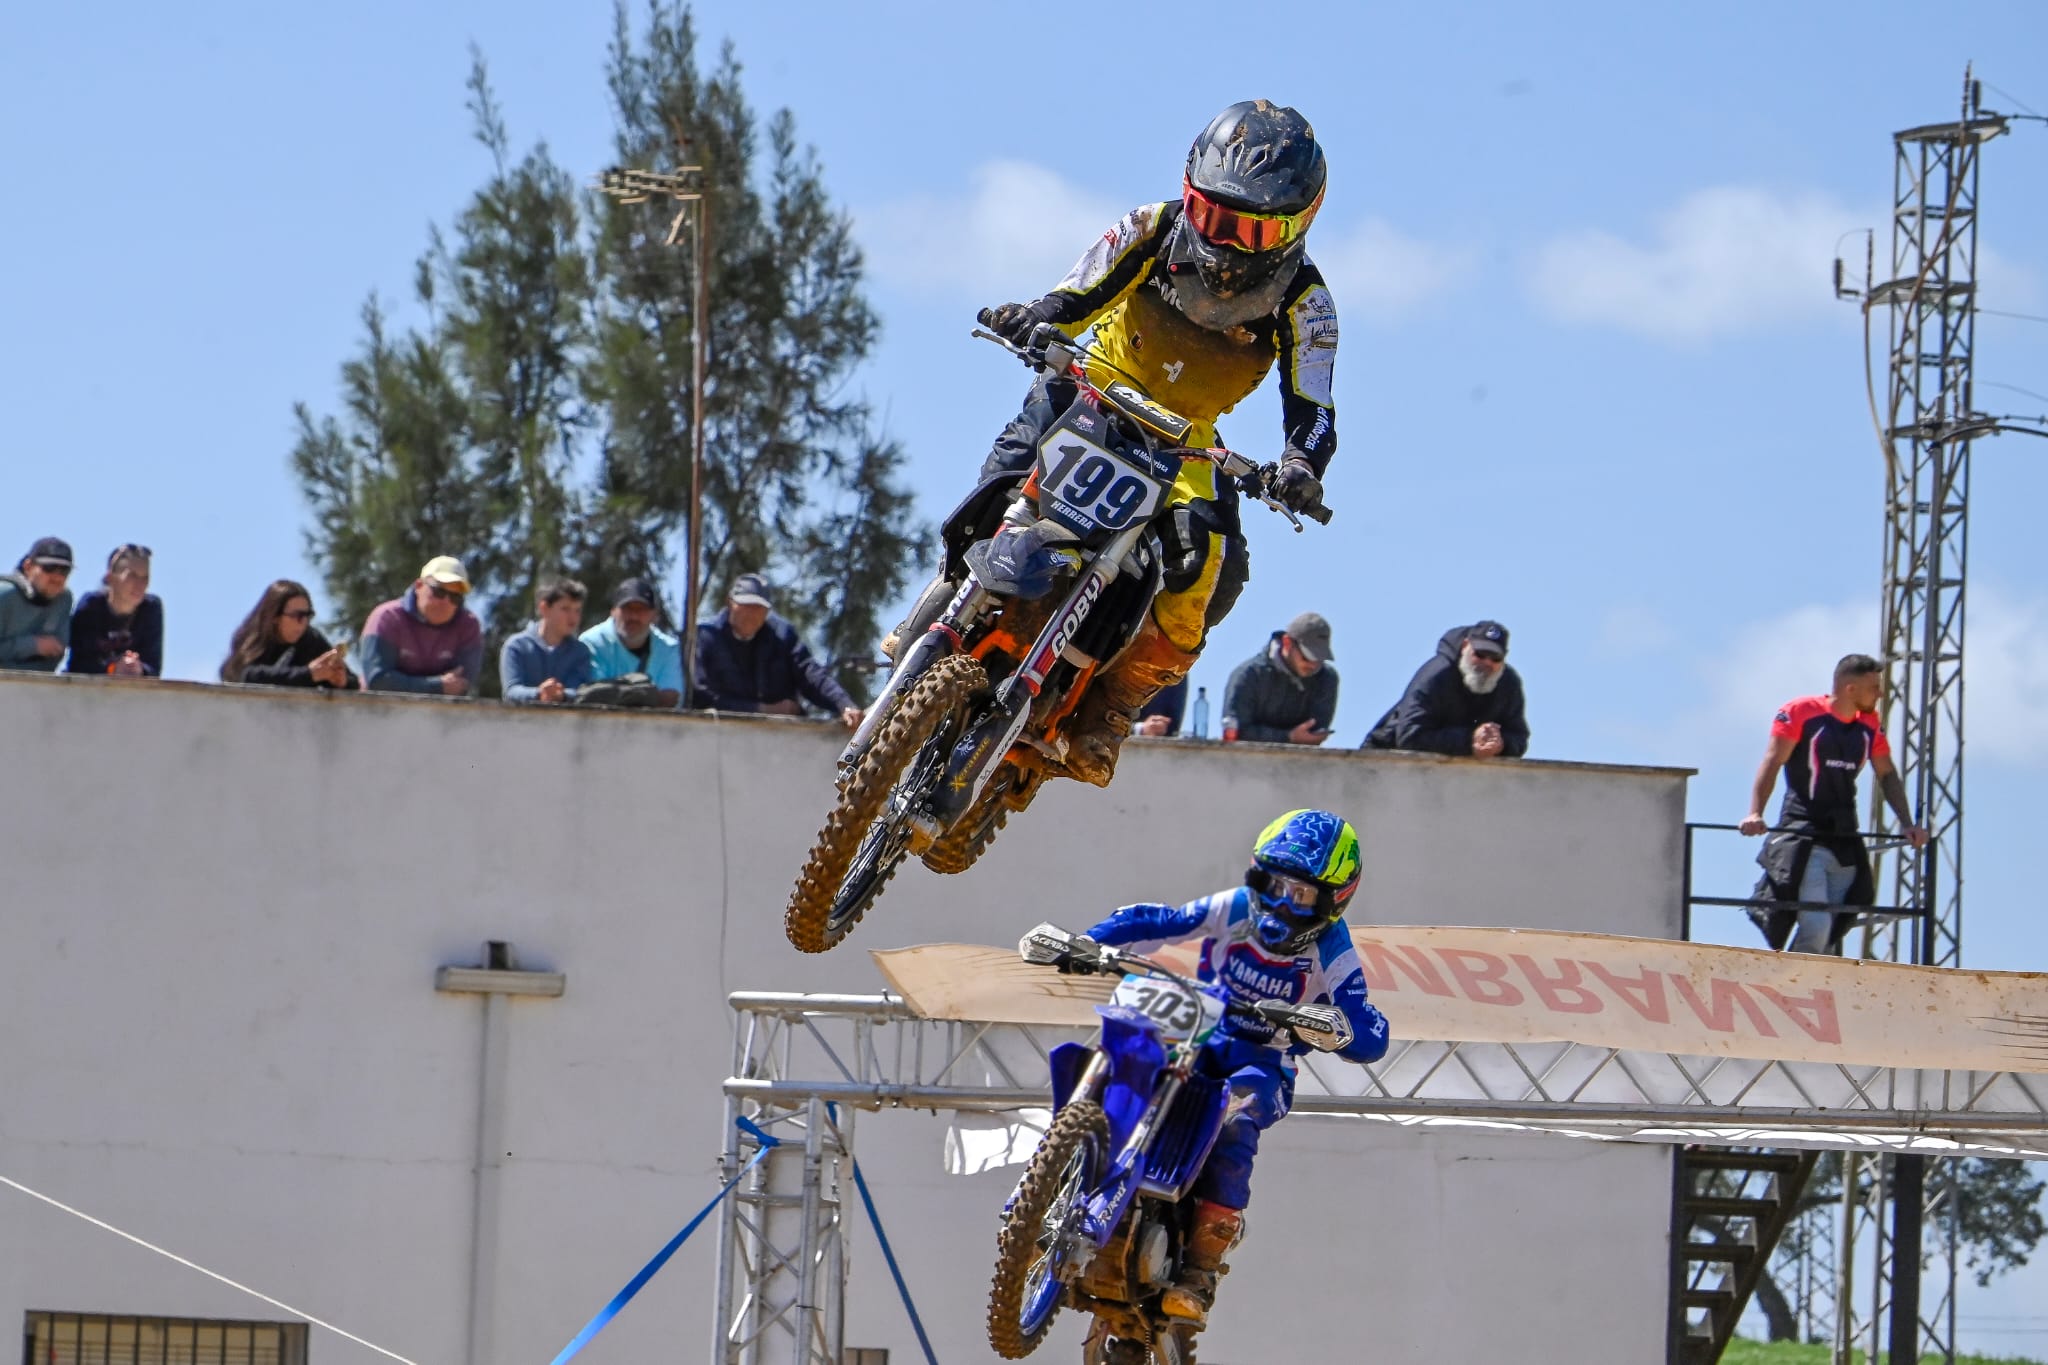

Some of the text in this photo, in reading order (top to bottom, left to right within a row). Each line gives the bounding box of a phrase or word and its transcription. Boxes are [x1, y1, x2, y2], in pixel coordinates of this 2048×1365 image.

[1140, 451, 1169, 473] Morista
[1041, 444, 1148, 530] 199
[1050, 500, 1095, 530] HERRERA
[1229, 955, 1294, 998] YAMAHA
[1134, 986, 1198, 1031] 303
